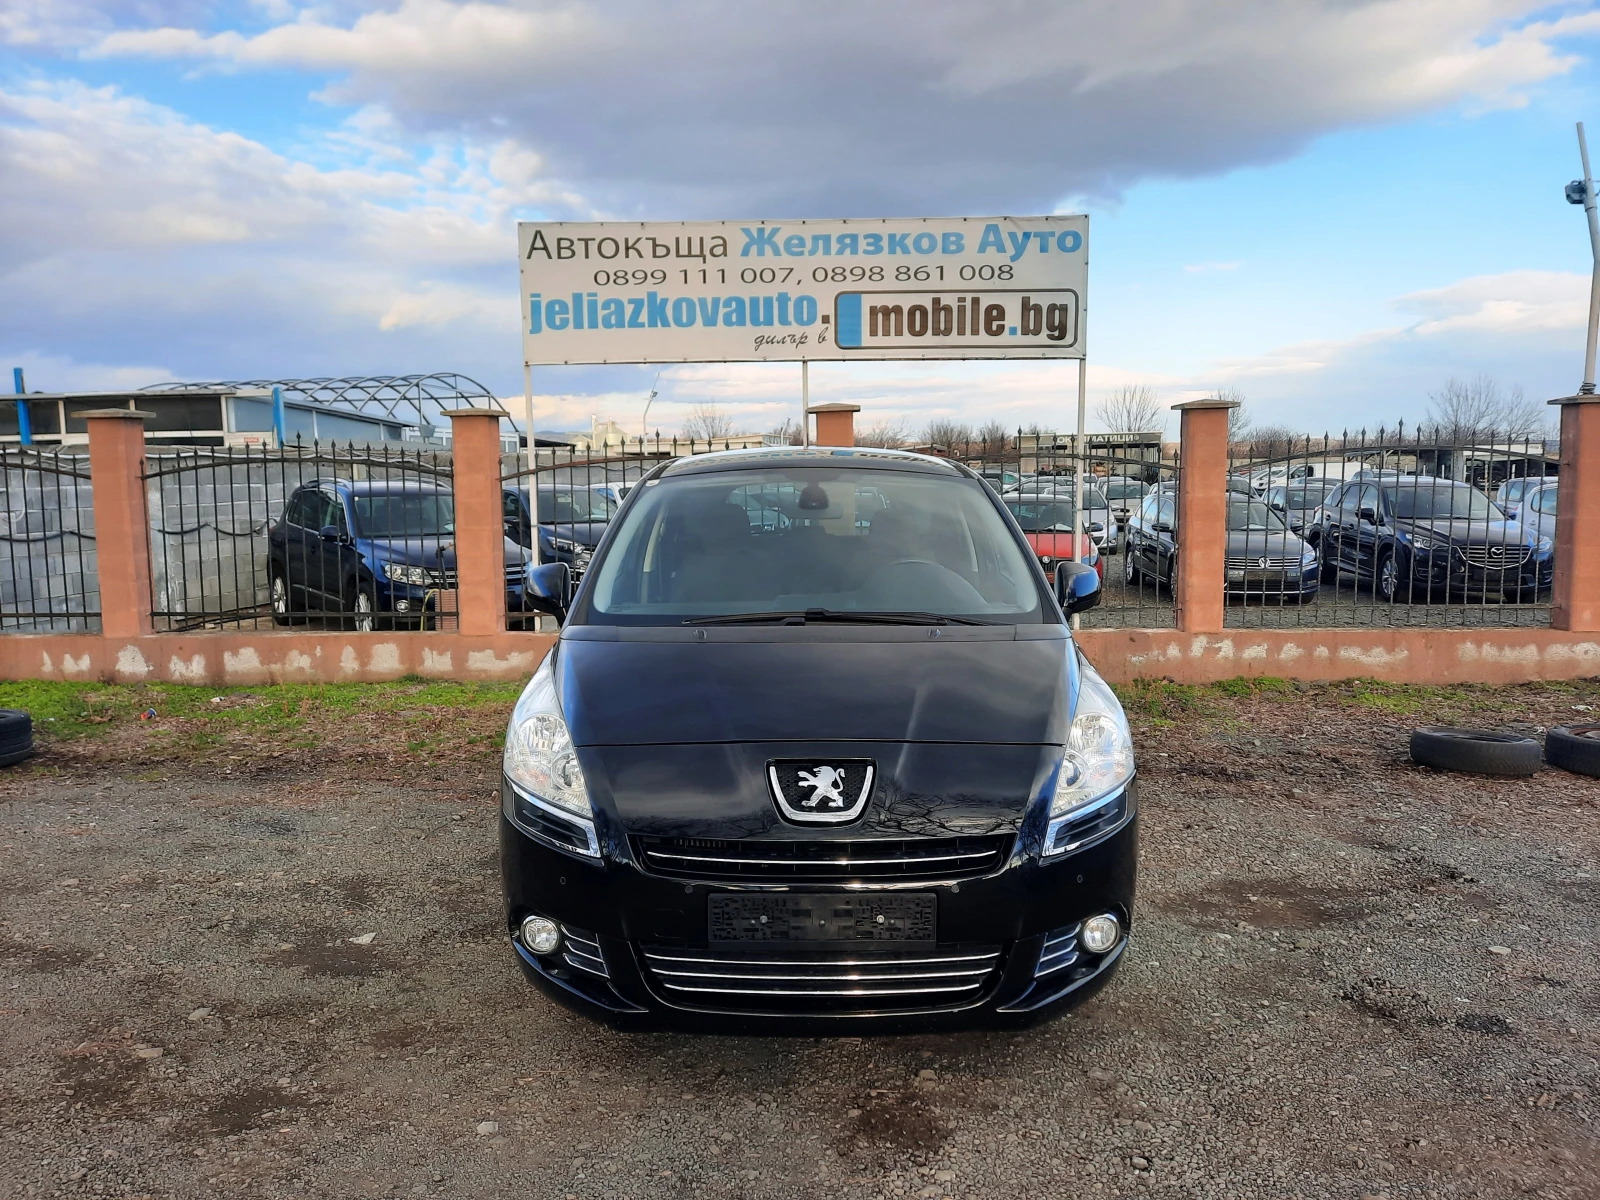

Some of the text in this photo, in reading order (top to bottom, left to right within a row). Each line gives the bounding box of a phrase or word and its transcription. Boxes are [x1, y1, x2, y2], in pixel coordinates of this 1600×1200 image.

[526, 223, 1083, 264] Автокъща Желязков Ауто
[593, 263, 1015, 286] 0899 111 007, 0898 861 008
[868, 295, 1069, 341] mobile.bg
